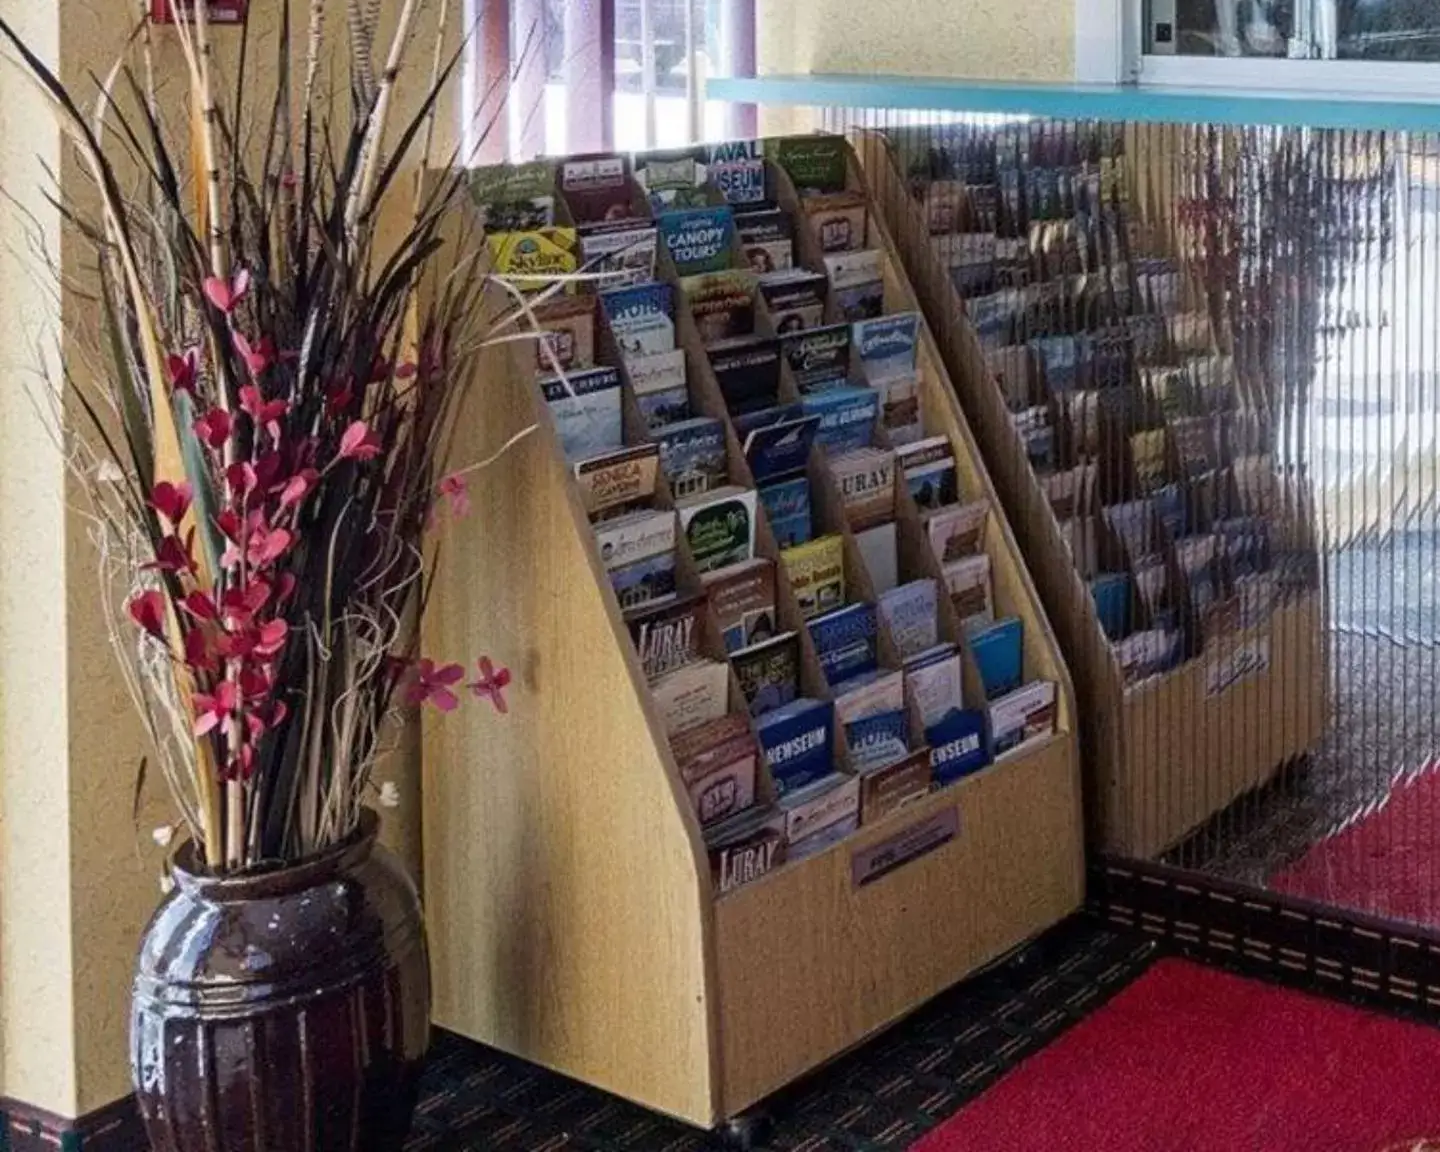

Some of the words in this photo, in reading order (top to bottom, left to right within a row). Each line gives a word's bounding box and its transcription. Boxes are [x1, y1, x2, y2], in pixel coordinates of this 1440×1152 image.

[667, 227, 725, 248] CANOPY
[840, 465, 891, 495] URAY
[928, 731, 981, 767] EWSEUM
[719, 839, 780, 891] LURAY
